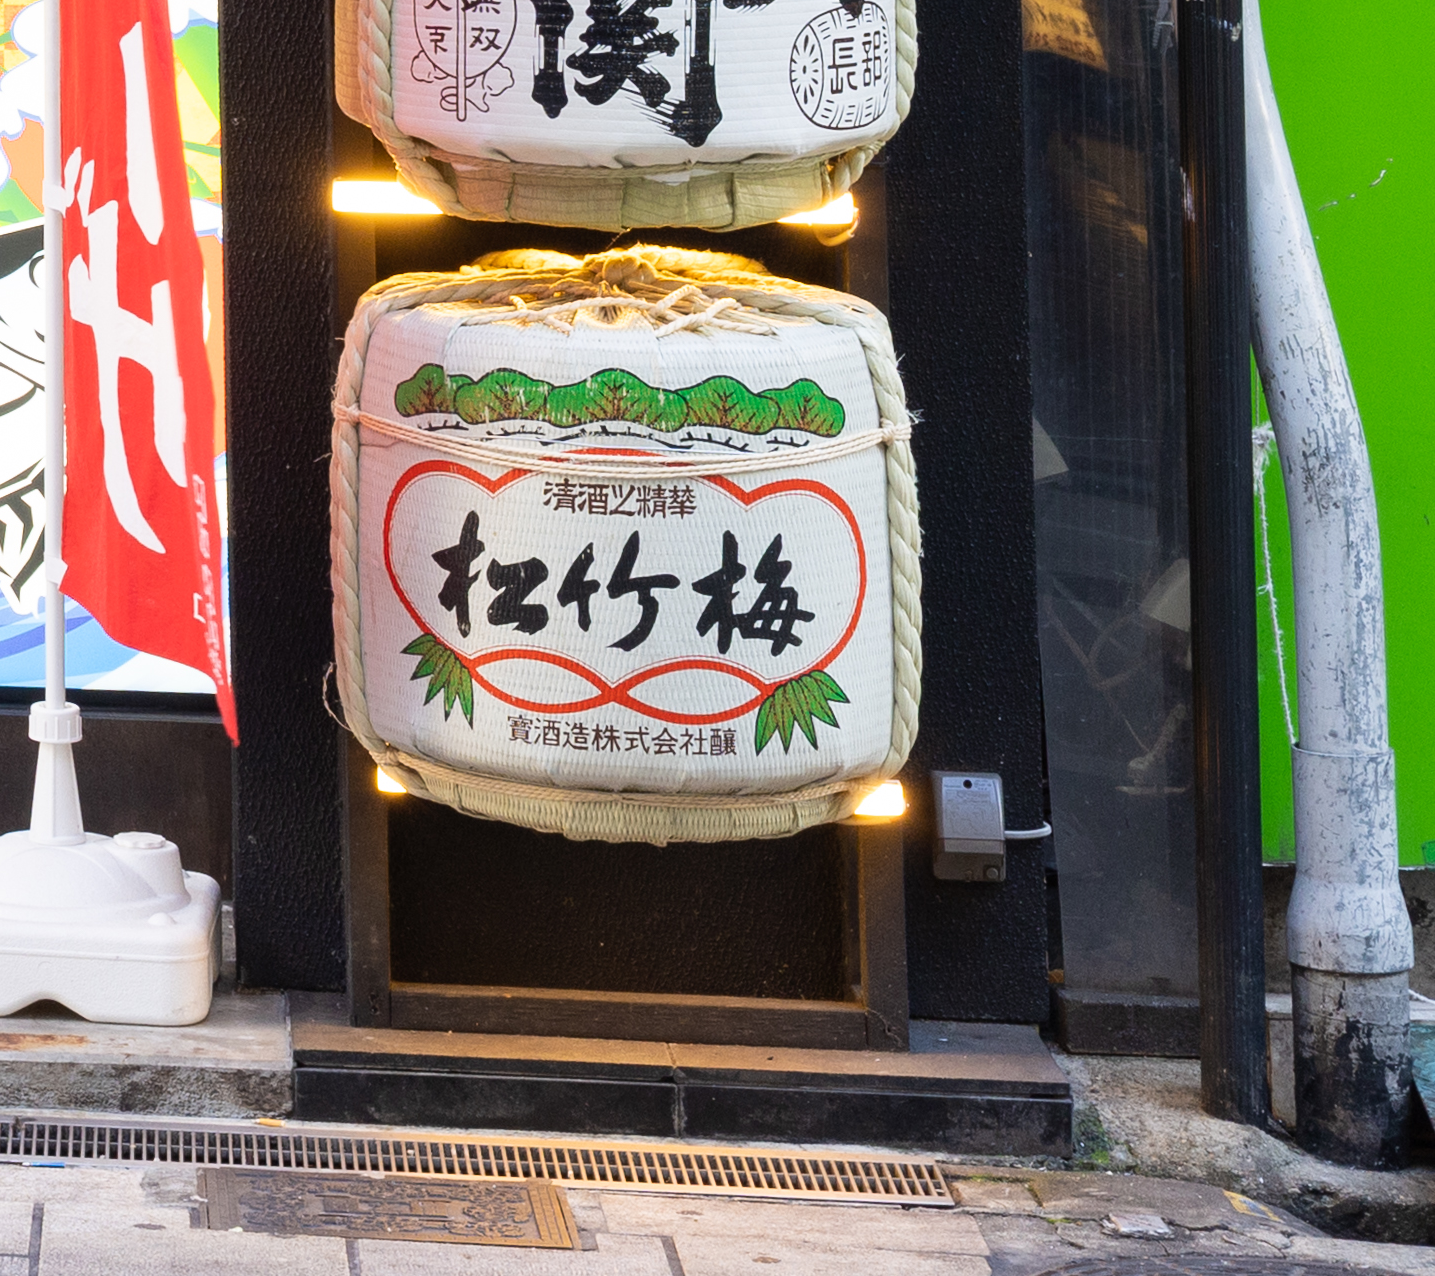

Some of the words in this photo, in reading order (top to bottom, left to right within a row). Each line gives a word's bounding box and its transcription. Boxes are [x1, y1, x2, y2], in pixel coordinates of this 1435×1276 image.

[827, 32, 884, 96] 長部
[431, 510, 816, 656] 松竹梅
